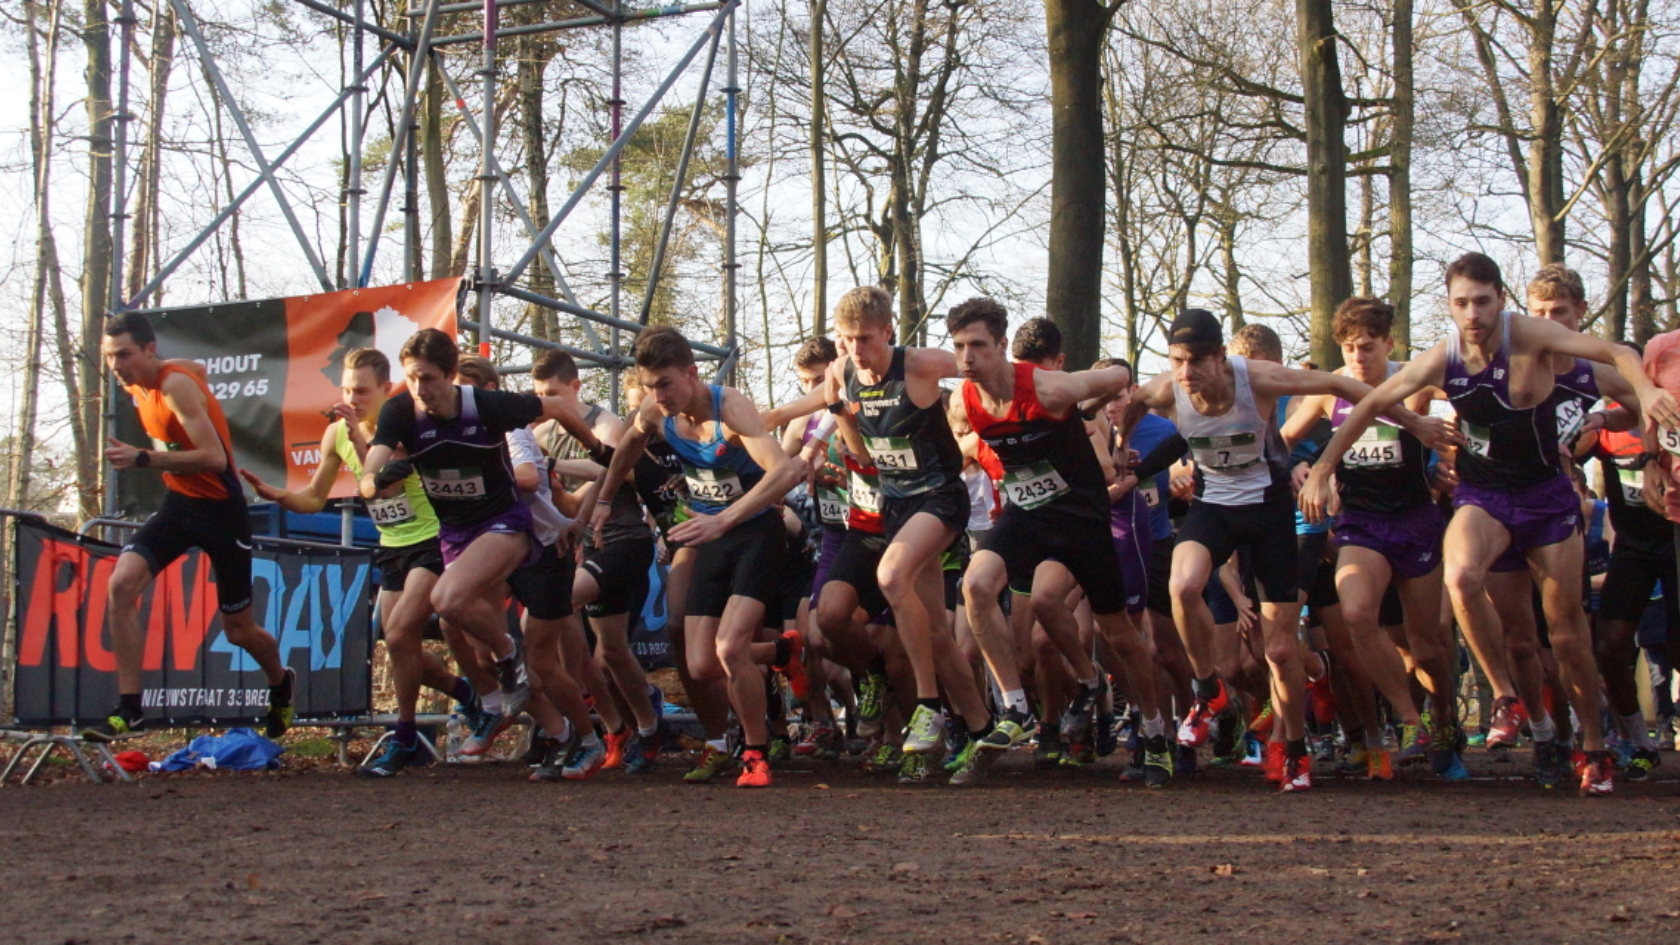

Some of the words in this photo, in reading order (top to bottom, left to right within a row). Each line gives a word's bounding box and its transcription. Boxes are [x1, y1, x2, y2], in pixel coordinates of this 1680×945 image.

[194, 353, 262, 375] HOUT
[243, 378, 269, 397] 65
[876, 454, 908, 467] 431
[1218, 451, 1231, 464] 7
[1348, 445, 1395, 461] 2445
[429, 481, 478, 495] 2443
[692, 482, 733, 498] 2422
[1014, 478, 1058, 502] 2433
[372, 502, 408, 521] 2435
